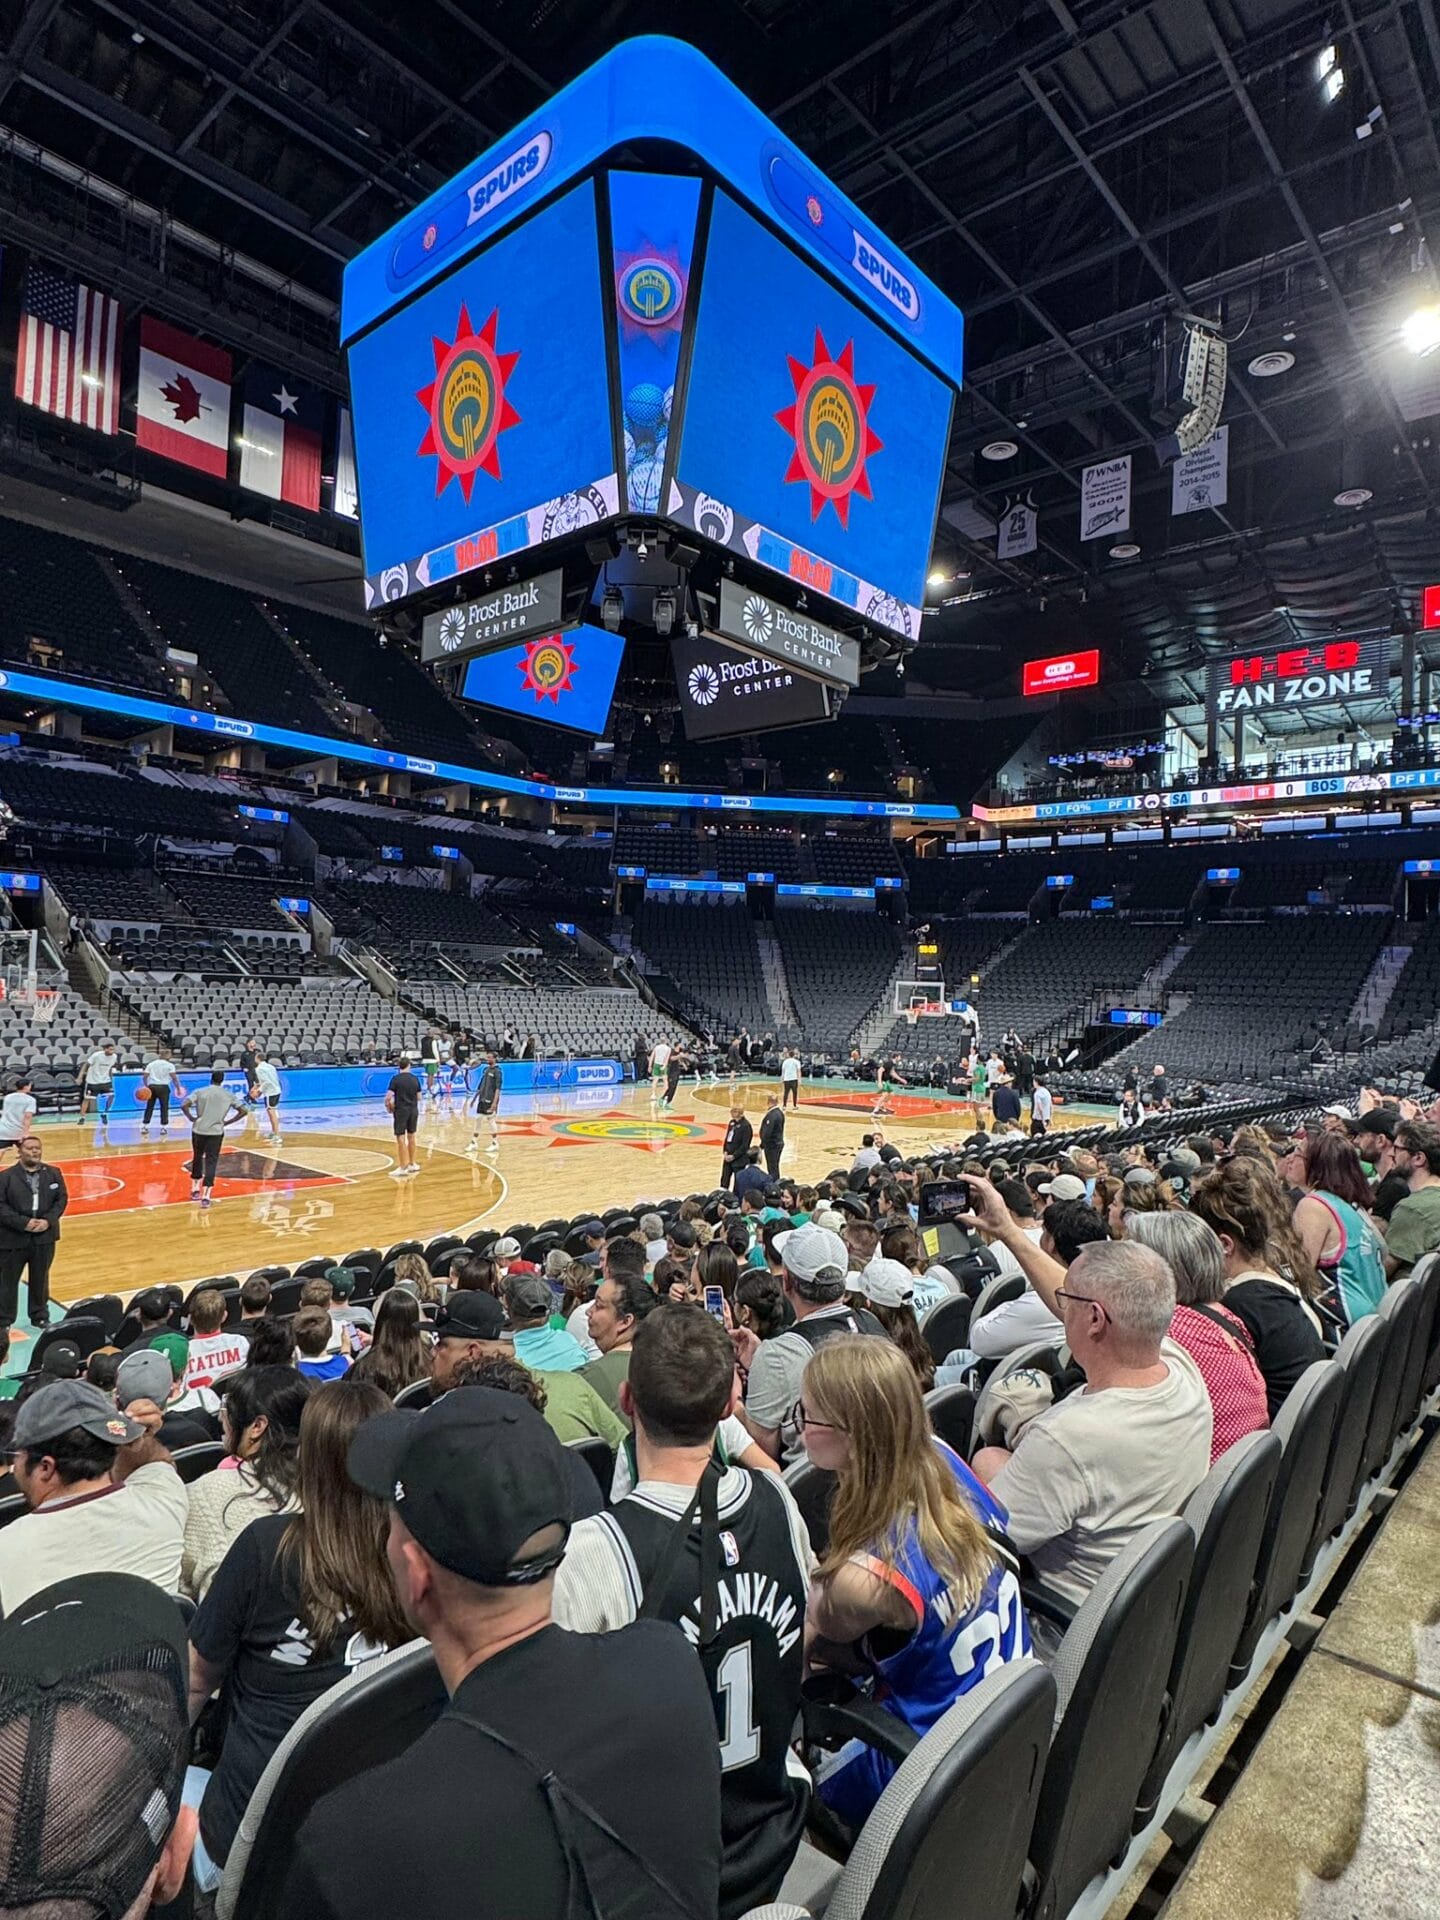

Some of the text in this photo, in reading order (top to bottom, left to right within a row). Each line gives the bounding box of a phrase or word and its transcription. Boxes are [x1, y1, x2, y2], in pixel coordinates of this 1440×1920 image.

[473, 145, 540, 212] SPURS
[858, 246, 911, 310] SPURS
[1095, 461, 1128, 478] WNBA
[1179, 461, 1221, 477] Champions
[1179, 471, 1221, 488] 2014-2015
[1009, 509, 1026, 533] 25
[467, 582, 540, 626] Frost Bank
[475, 615, 526, 640] CENTER
[775, 608, 842, 657] Frost Bank
[783, 640, 832, 669] CENTER
[718, 657, 760, 683] Frost
[733, 674, 793, 696] CENTER
[1217, 669, 1372, 711] FAN ZONE
[217, 720, 248, 733] SPURS
[1040, 807, 1053, 815] TO
[1108, 799, 1123, 809] PF
[1172, 792, 1187, 805] SA
[1311, 779, 1338, 792] BOS
[1395, 775, 1415, 785] PF
[580, 1068, 610, 1079] SPURS
[188, 1347, 240, 1374] TATUM
[715, 1639, 762, 1773] 1
